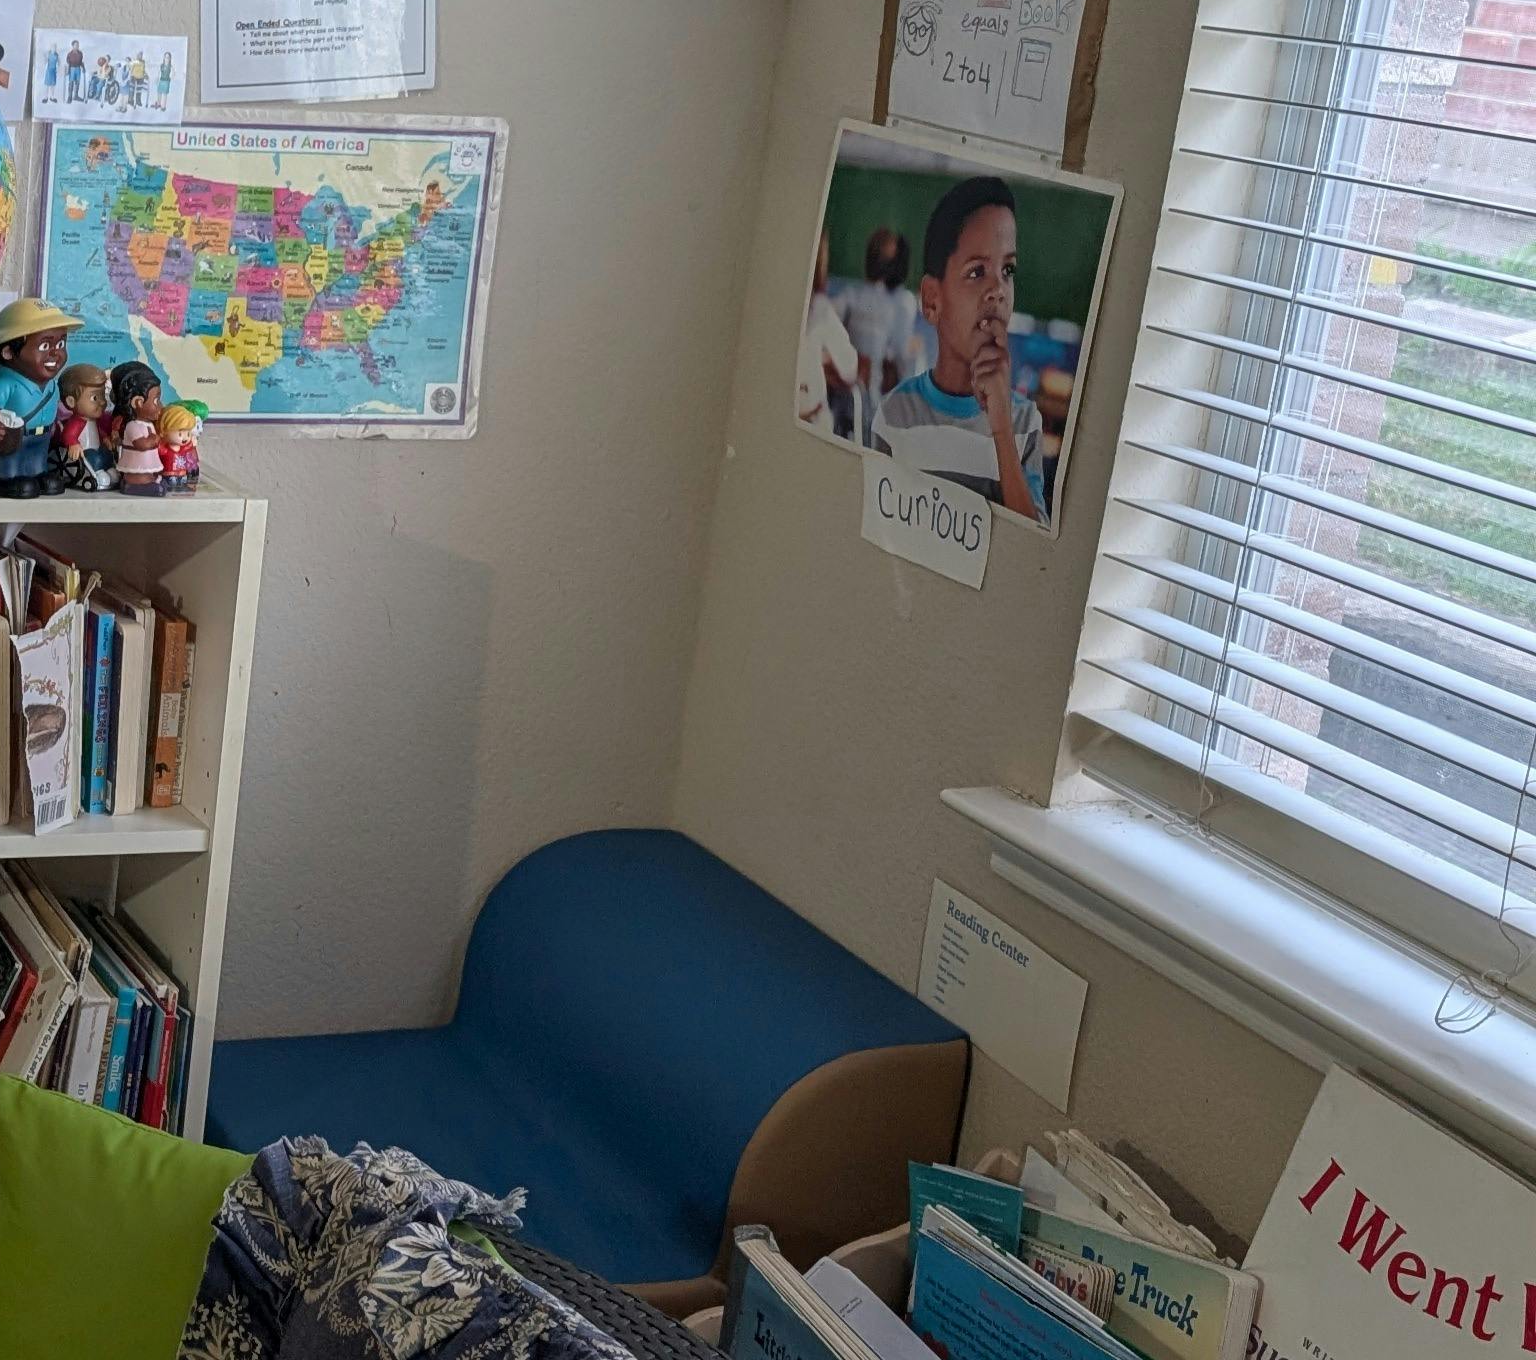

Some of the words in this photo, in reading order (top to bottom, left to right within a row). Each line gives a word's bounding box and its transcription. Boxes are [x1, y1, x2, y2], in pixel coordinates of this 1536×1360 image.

[236, 21, 255, 31] Open
[258, 20, 280, 28] Ended
[961, 15, 1008, 40] equals
[176, 132, 226, 147] United
[231, 135, 282, 148] States
[282, 137, 296, 148] of
[301, 136, 364, 151] America
[346, 164, 373, 172] Canada
[110, 356, 116, 364] N
[877, 478, 984, 554] Curious
[160, 694, 173, 737] Animals
[946, 899, 989, 945] Reading
[991, 931, 1030, 968] Center
[77, 1081, 89, 1096] To
[108, 1055, 124, 1092] Smiles
[1298, 1157, 1346, 1215] I
[1337, 1187, 1504, 1342] Went
[1129, 1262, 1199, 1338] Truck
